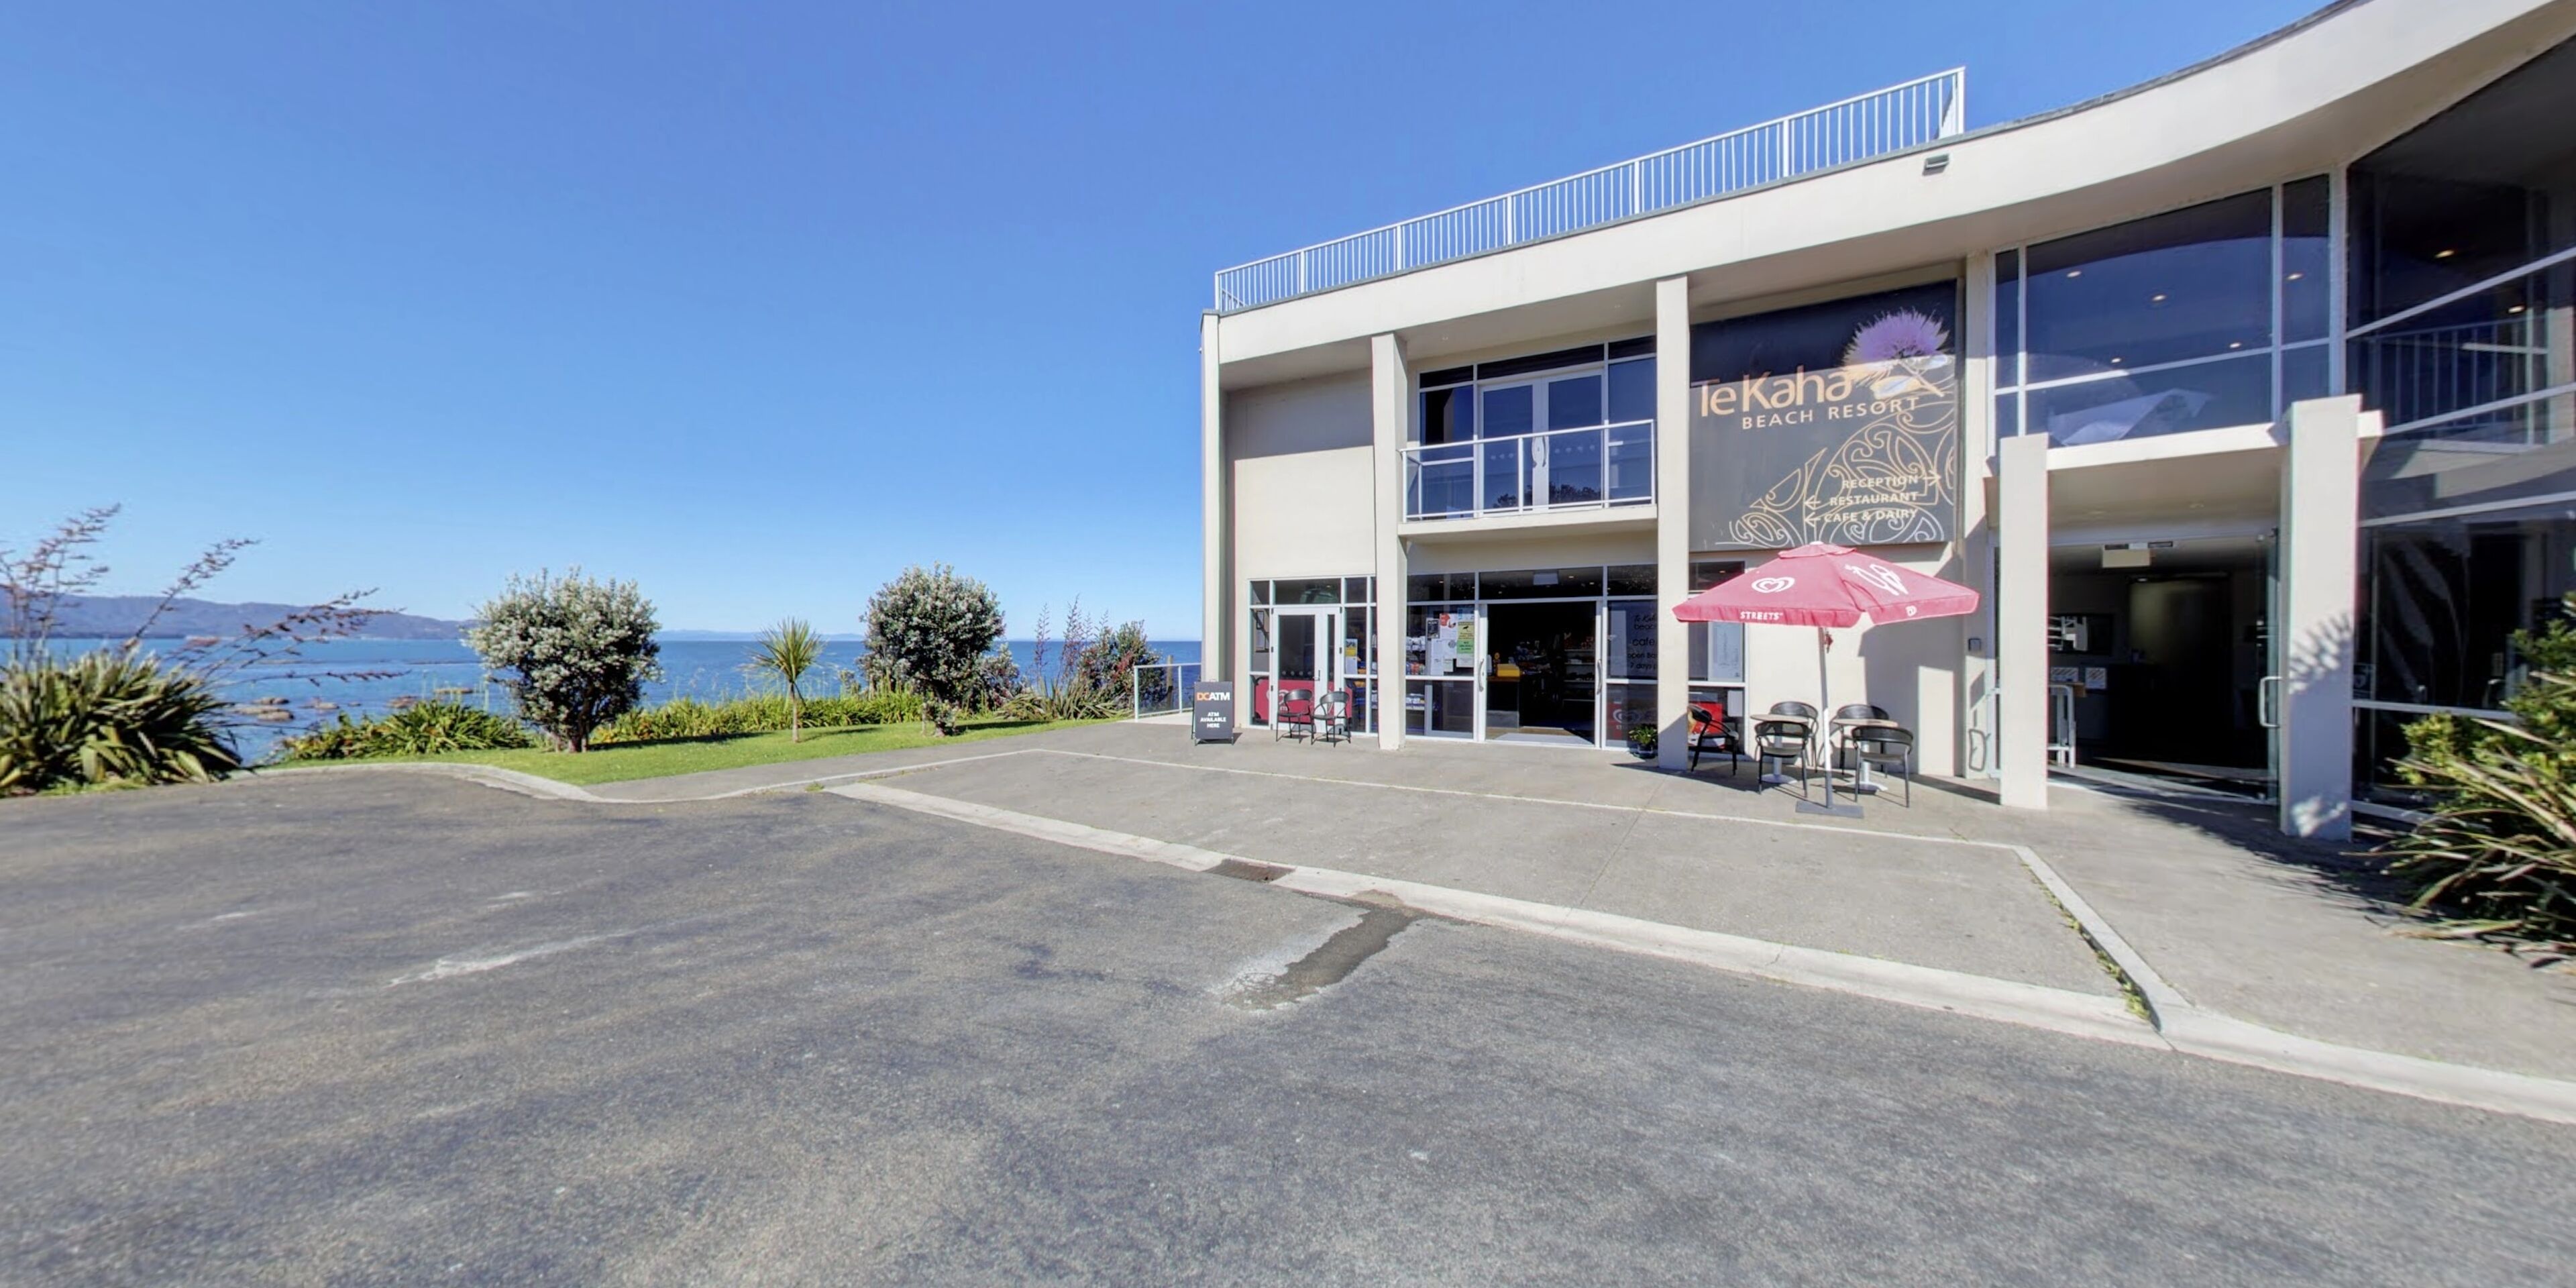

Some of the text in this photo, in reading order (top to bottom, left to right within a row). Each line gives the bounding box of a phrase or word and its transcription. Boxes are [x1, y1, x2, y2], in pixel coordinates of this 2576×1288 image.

[1690, 365, 1855, 417] Te Kaha
[1742, 396, 1920, 430] BEACH RESORT
[1842, 475, 1919, 489] RECEPTION
[1829, 492, 1919, 506] RESTAURANT
[1824, 508, 1918, 523] CAFE & DAIRY
[1739, 610, 1780, 621] STREETS
[1632, 637, 1656, 646] cafe
[1197, 692, 1230, 701] DCATM
